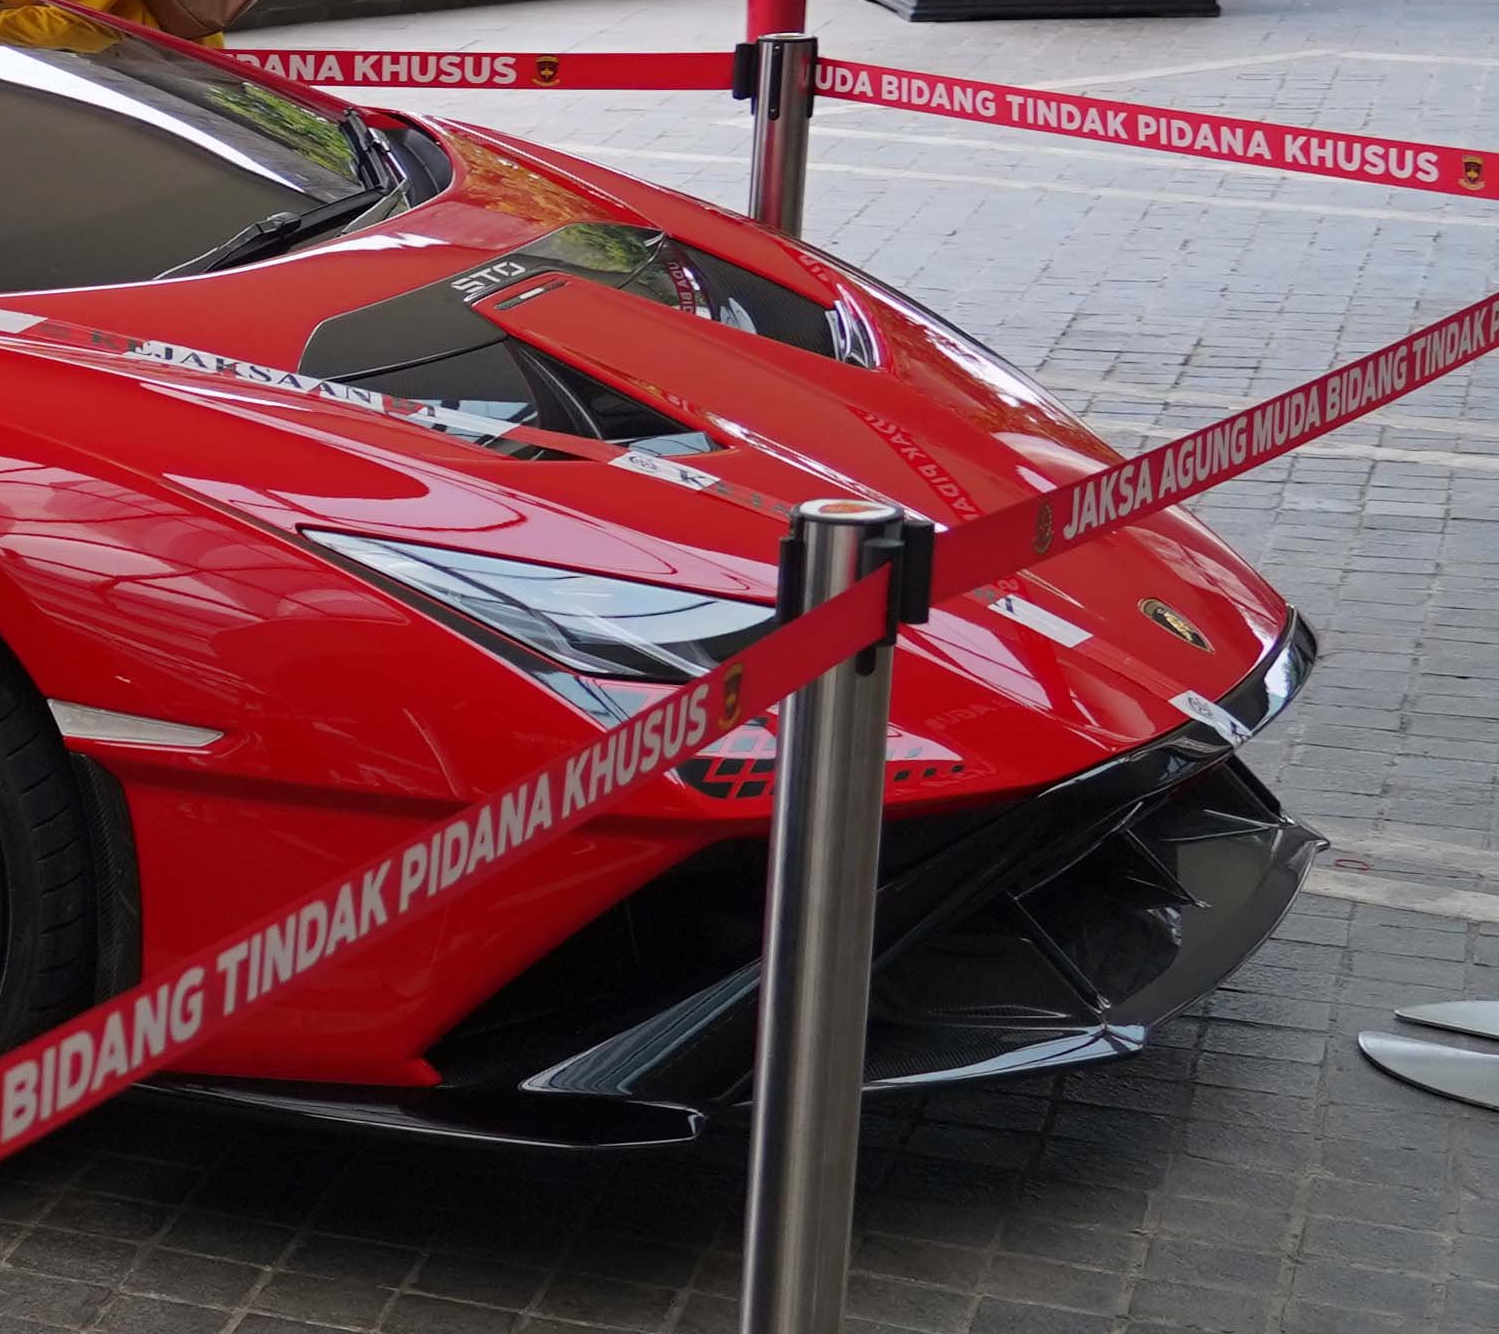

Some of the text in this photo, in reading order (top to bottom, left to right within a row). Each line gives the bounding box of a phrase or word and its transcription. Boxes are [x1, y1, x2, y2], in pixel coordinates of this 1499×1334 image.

[352, 54, 518, 85] KHUSUS
[814, 63, 1440, 184] UDA BIDANG TINDAK PIDANA KHUSUS
[450, 260, 527, 295] STO
[1063, 458, 1152, 541] JAKSA
[1158, 417, 1249, 500] AGUNG
[1253, 385, 1321, 457] MUDA
[1325, 345, 1408, 423] BIDANG
[1412, 307, 1488, 383] TINDAK
[0, 970, 205, 1145] BIDANG
[214, 860, 391, 1019] TINDAK
[399, 779, 553, 922] PIDANA
[562, 684, 711, 816] KHUSUS
